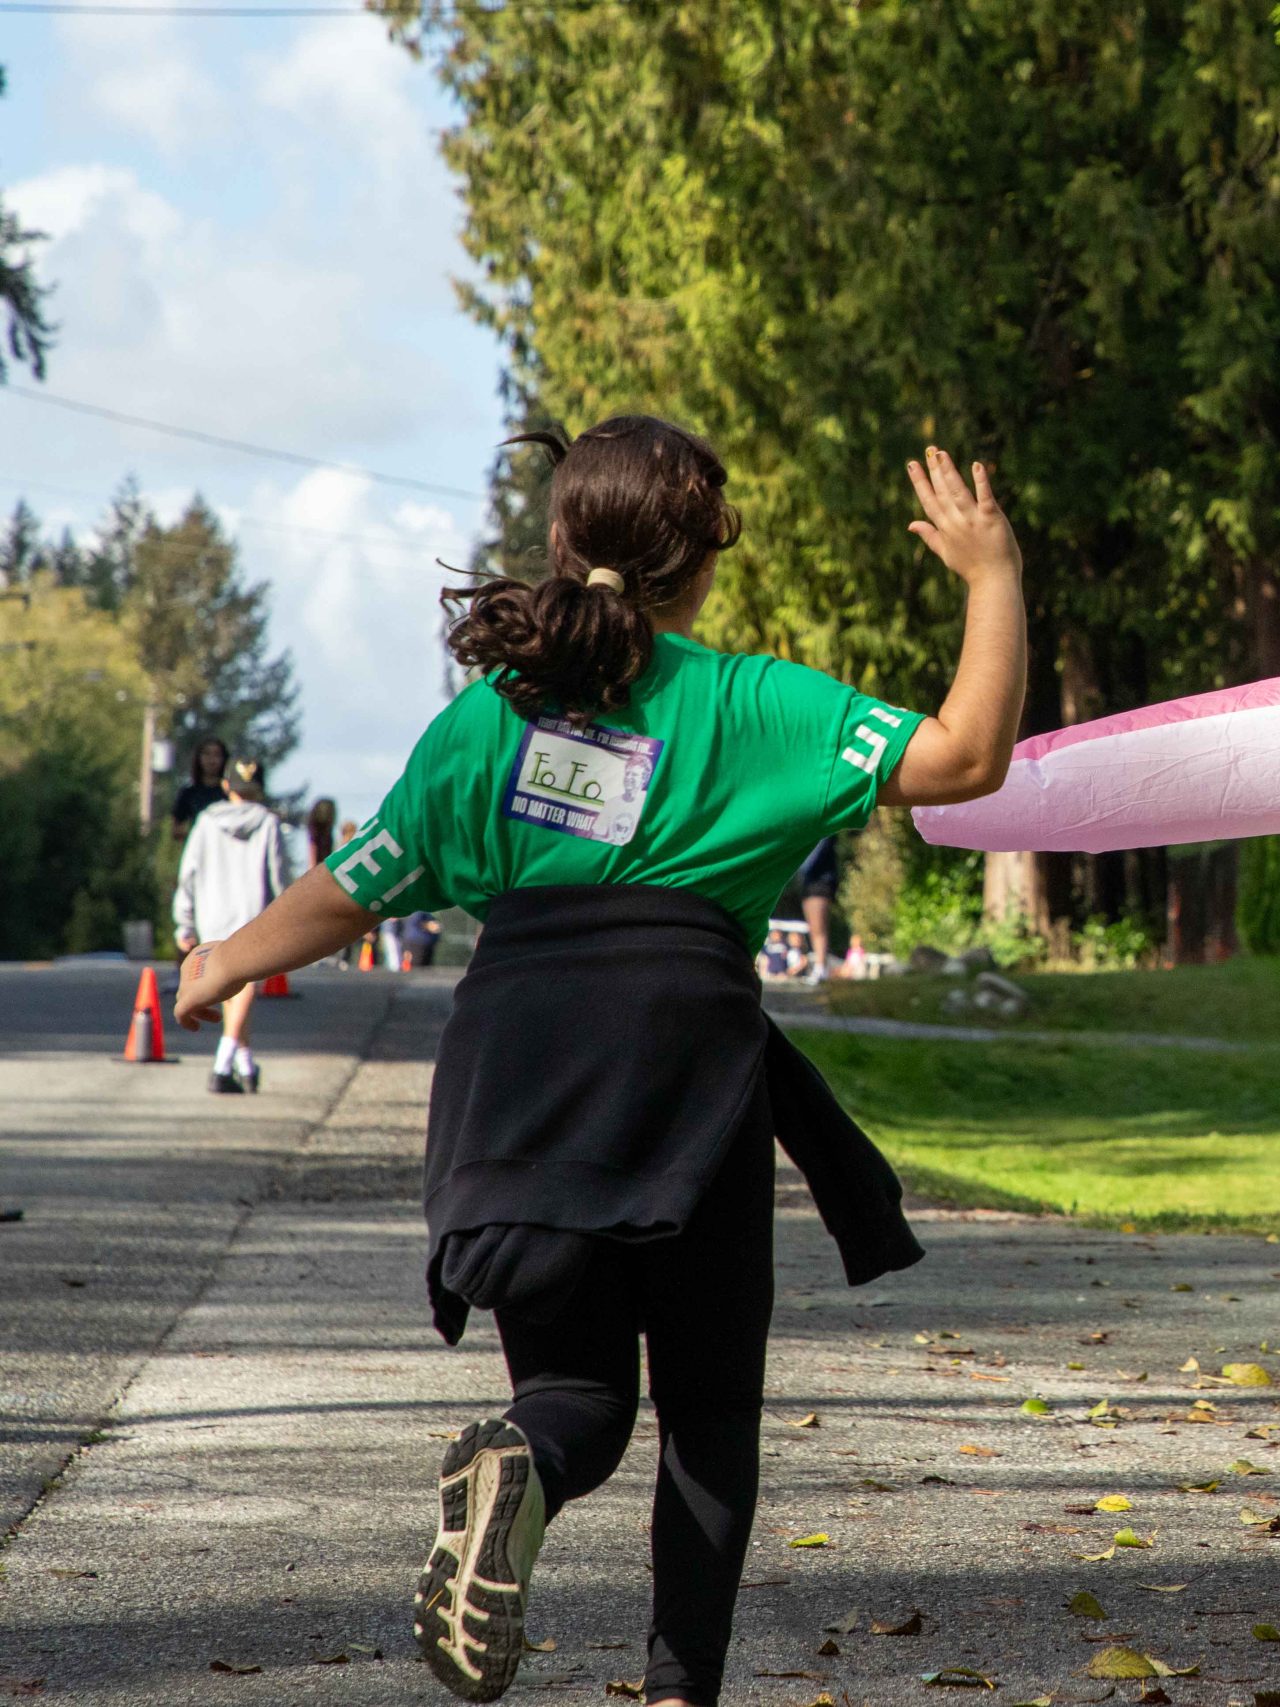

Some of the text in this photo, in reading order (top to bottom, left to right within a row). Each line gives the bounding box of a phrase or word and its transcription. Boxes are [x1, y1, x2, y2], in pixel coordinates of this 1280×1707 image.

[511, 795, 528, 813] NO
[526, 799, 567, 825] MATTER
[565, 810, 597, 831] WHAT
